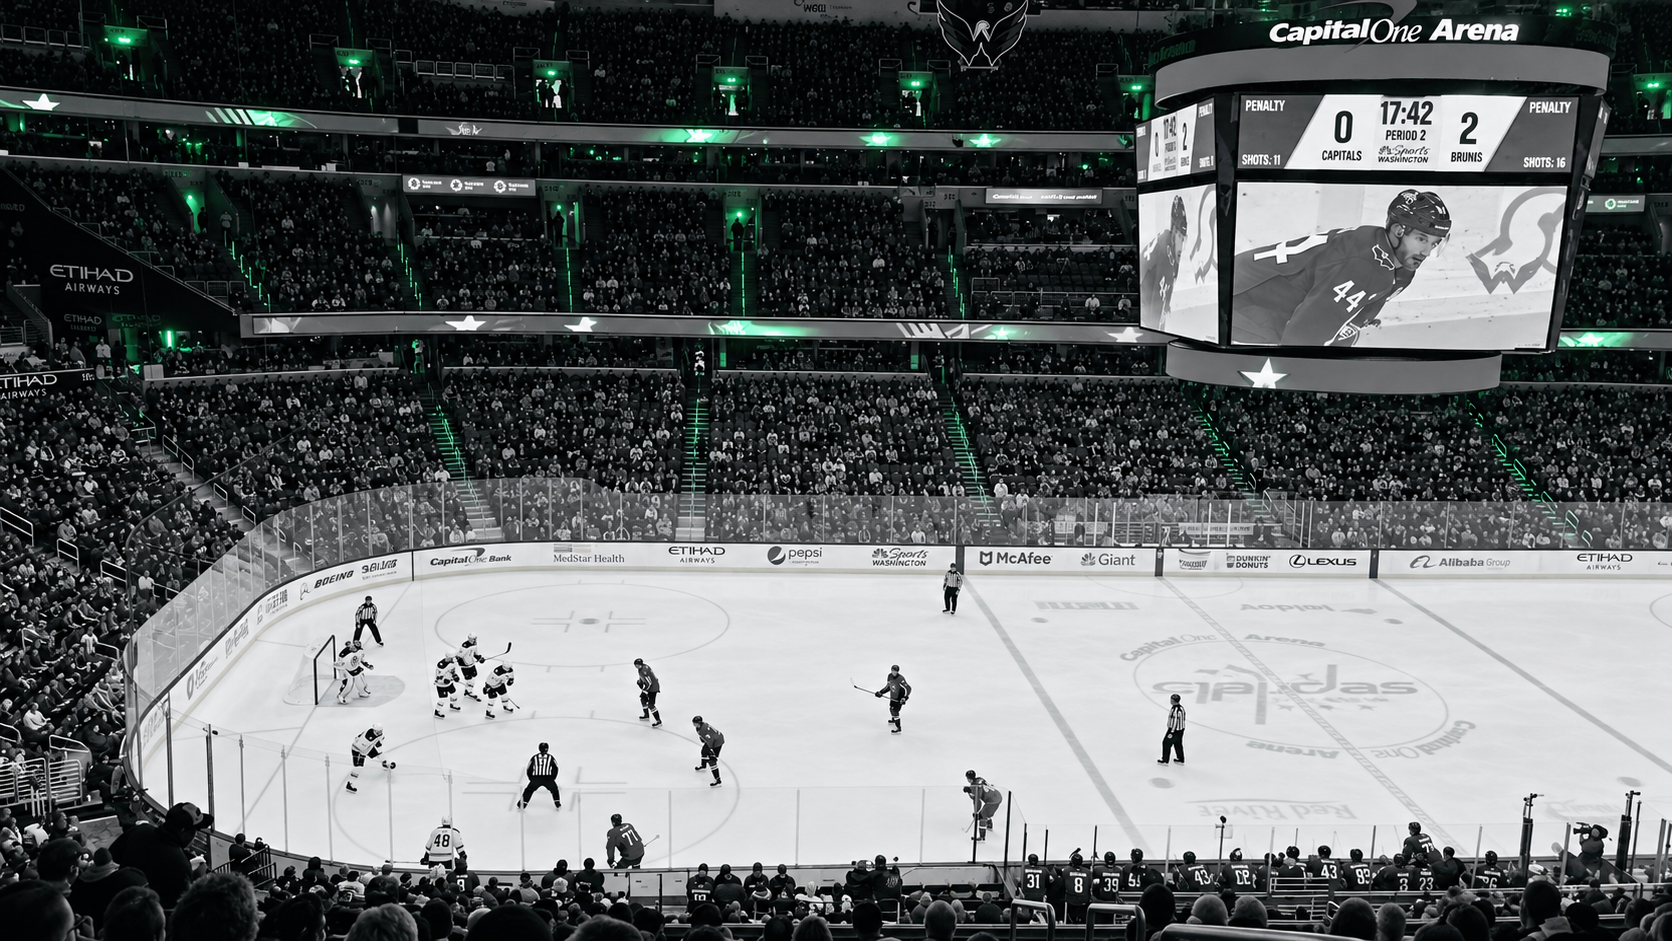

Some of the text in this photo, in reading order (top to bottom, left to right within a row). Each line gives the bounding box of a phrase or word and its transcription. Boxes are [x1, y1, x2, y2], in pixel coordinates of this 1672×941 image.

[1429, 19, 1519, 41] Arena
[1245, 99, 1285, 111] PENALTY
[1530, 101, 1571, 113] PENALTY
[1381, 100, 1433, 125] 17:42
[1335, 110, 1353, 143] 0
[1460, 112, 1478, 144] 2
[1386, 130, 1426, 140] PERIOD 2
[1242, 154, 1281, 165] SHOTS: 11
[1322, 150, 1362, 161] CAPITALS
[1378, 156, 1429, 164] WASHINGTON
[1523, 157, 1566, 168] SHOTS: 16
[50, 264, 134, 282] ETIHAD
[65, 282, 120, 295] AIRWAYS
[0, 374, 57, 389] TIHAD
[0, 388, 47, 400] AIRWAYS
[668, 546, 726, 555] ETIHAD
[788, 547, 822, 560] pepsi
[889, 548, 929, 561] Sports
[489, 554, 512, 562] Bank
[553, 554, 625, 563] MedStar Health
[996, 551, 1052, 564] McAfee
[1098, 553, 1135, 566] Giant
[1307, 558, 1357, 566] LEXUS
[1439, 557, 1510, 568] Alibaba Group
[1576, 553, 1633, 562] ETIHAD
[314, 570, 354, 589] BOEING
[1244, 634, 1325, 647] Arena
[434, 833, 450, 847] 48
[622, 830, 639, 846] 77
[1321, 865, 1338, 879] 43
[1026, 873, 1040, 889] 31
[1074, 877, 1084, 893] 8
[1103, 878, 1119, 893] 39
[1419, 877, 1434, 891] 23
